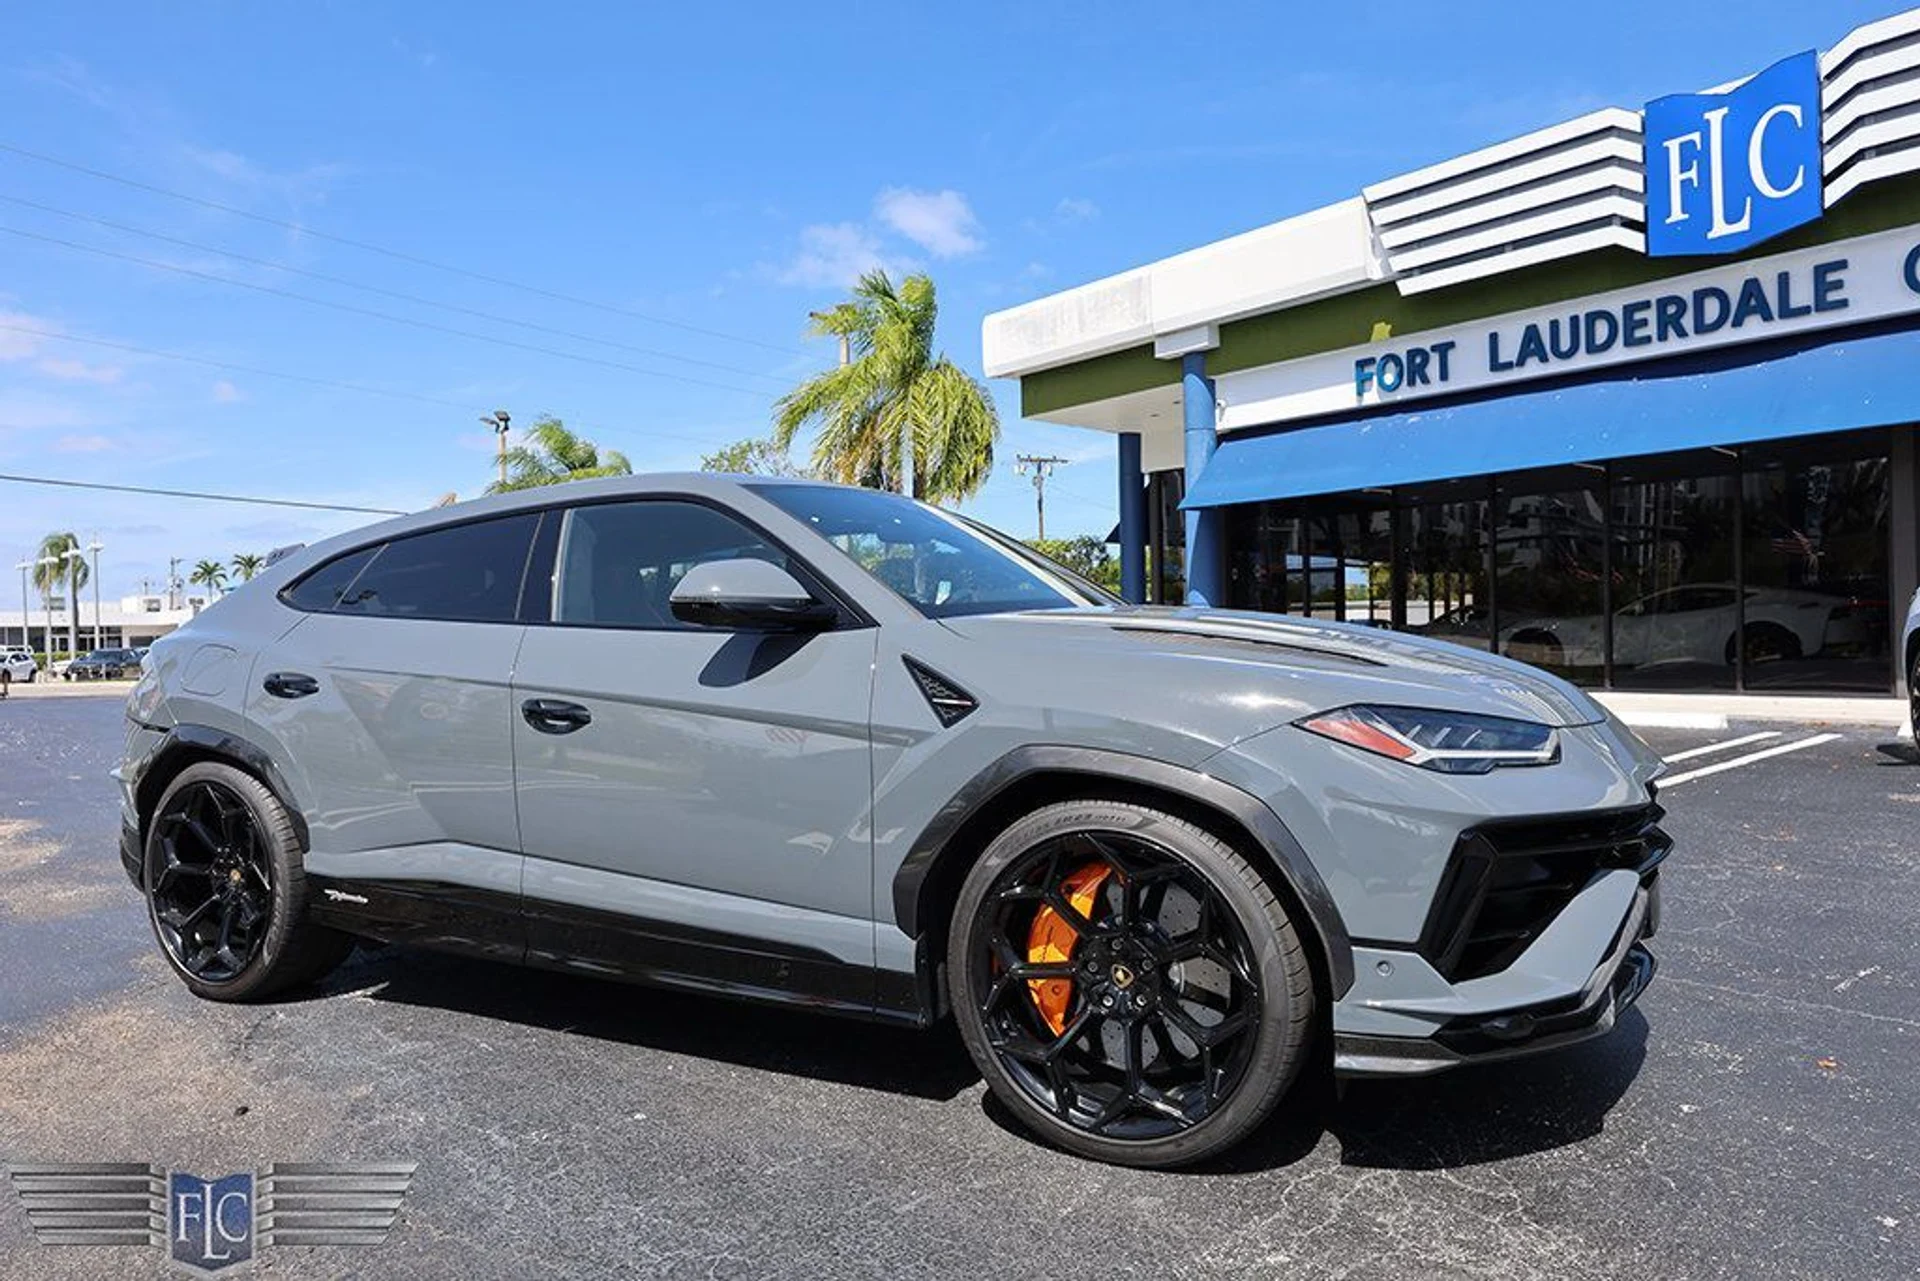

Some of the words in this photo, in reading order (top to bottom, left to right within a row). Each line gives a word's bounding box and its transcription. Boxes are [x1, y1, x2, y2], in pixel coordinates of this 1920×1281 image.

[1663, 103, 1803, 239] FLC
[1355, 341, 1456, 397] FORT
[1488, 258, 1849, 374] LAUDERDALE
